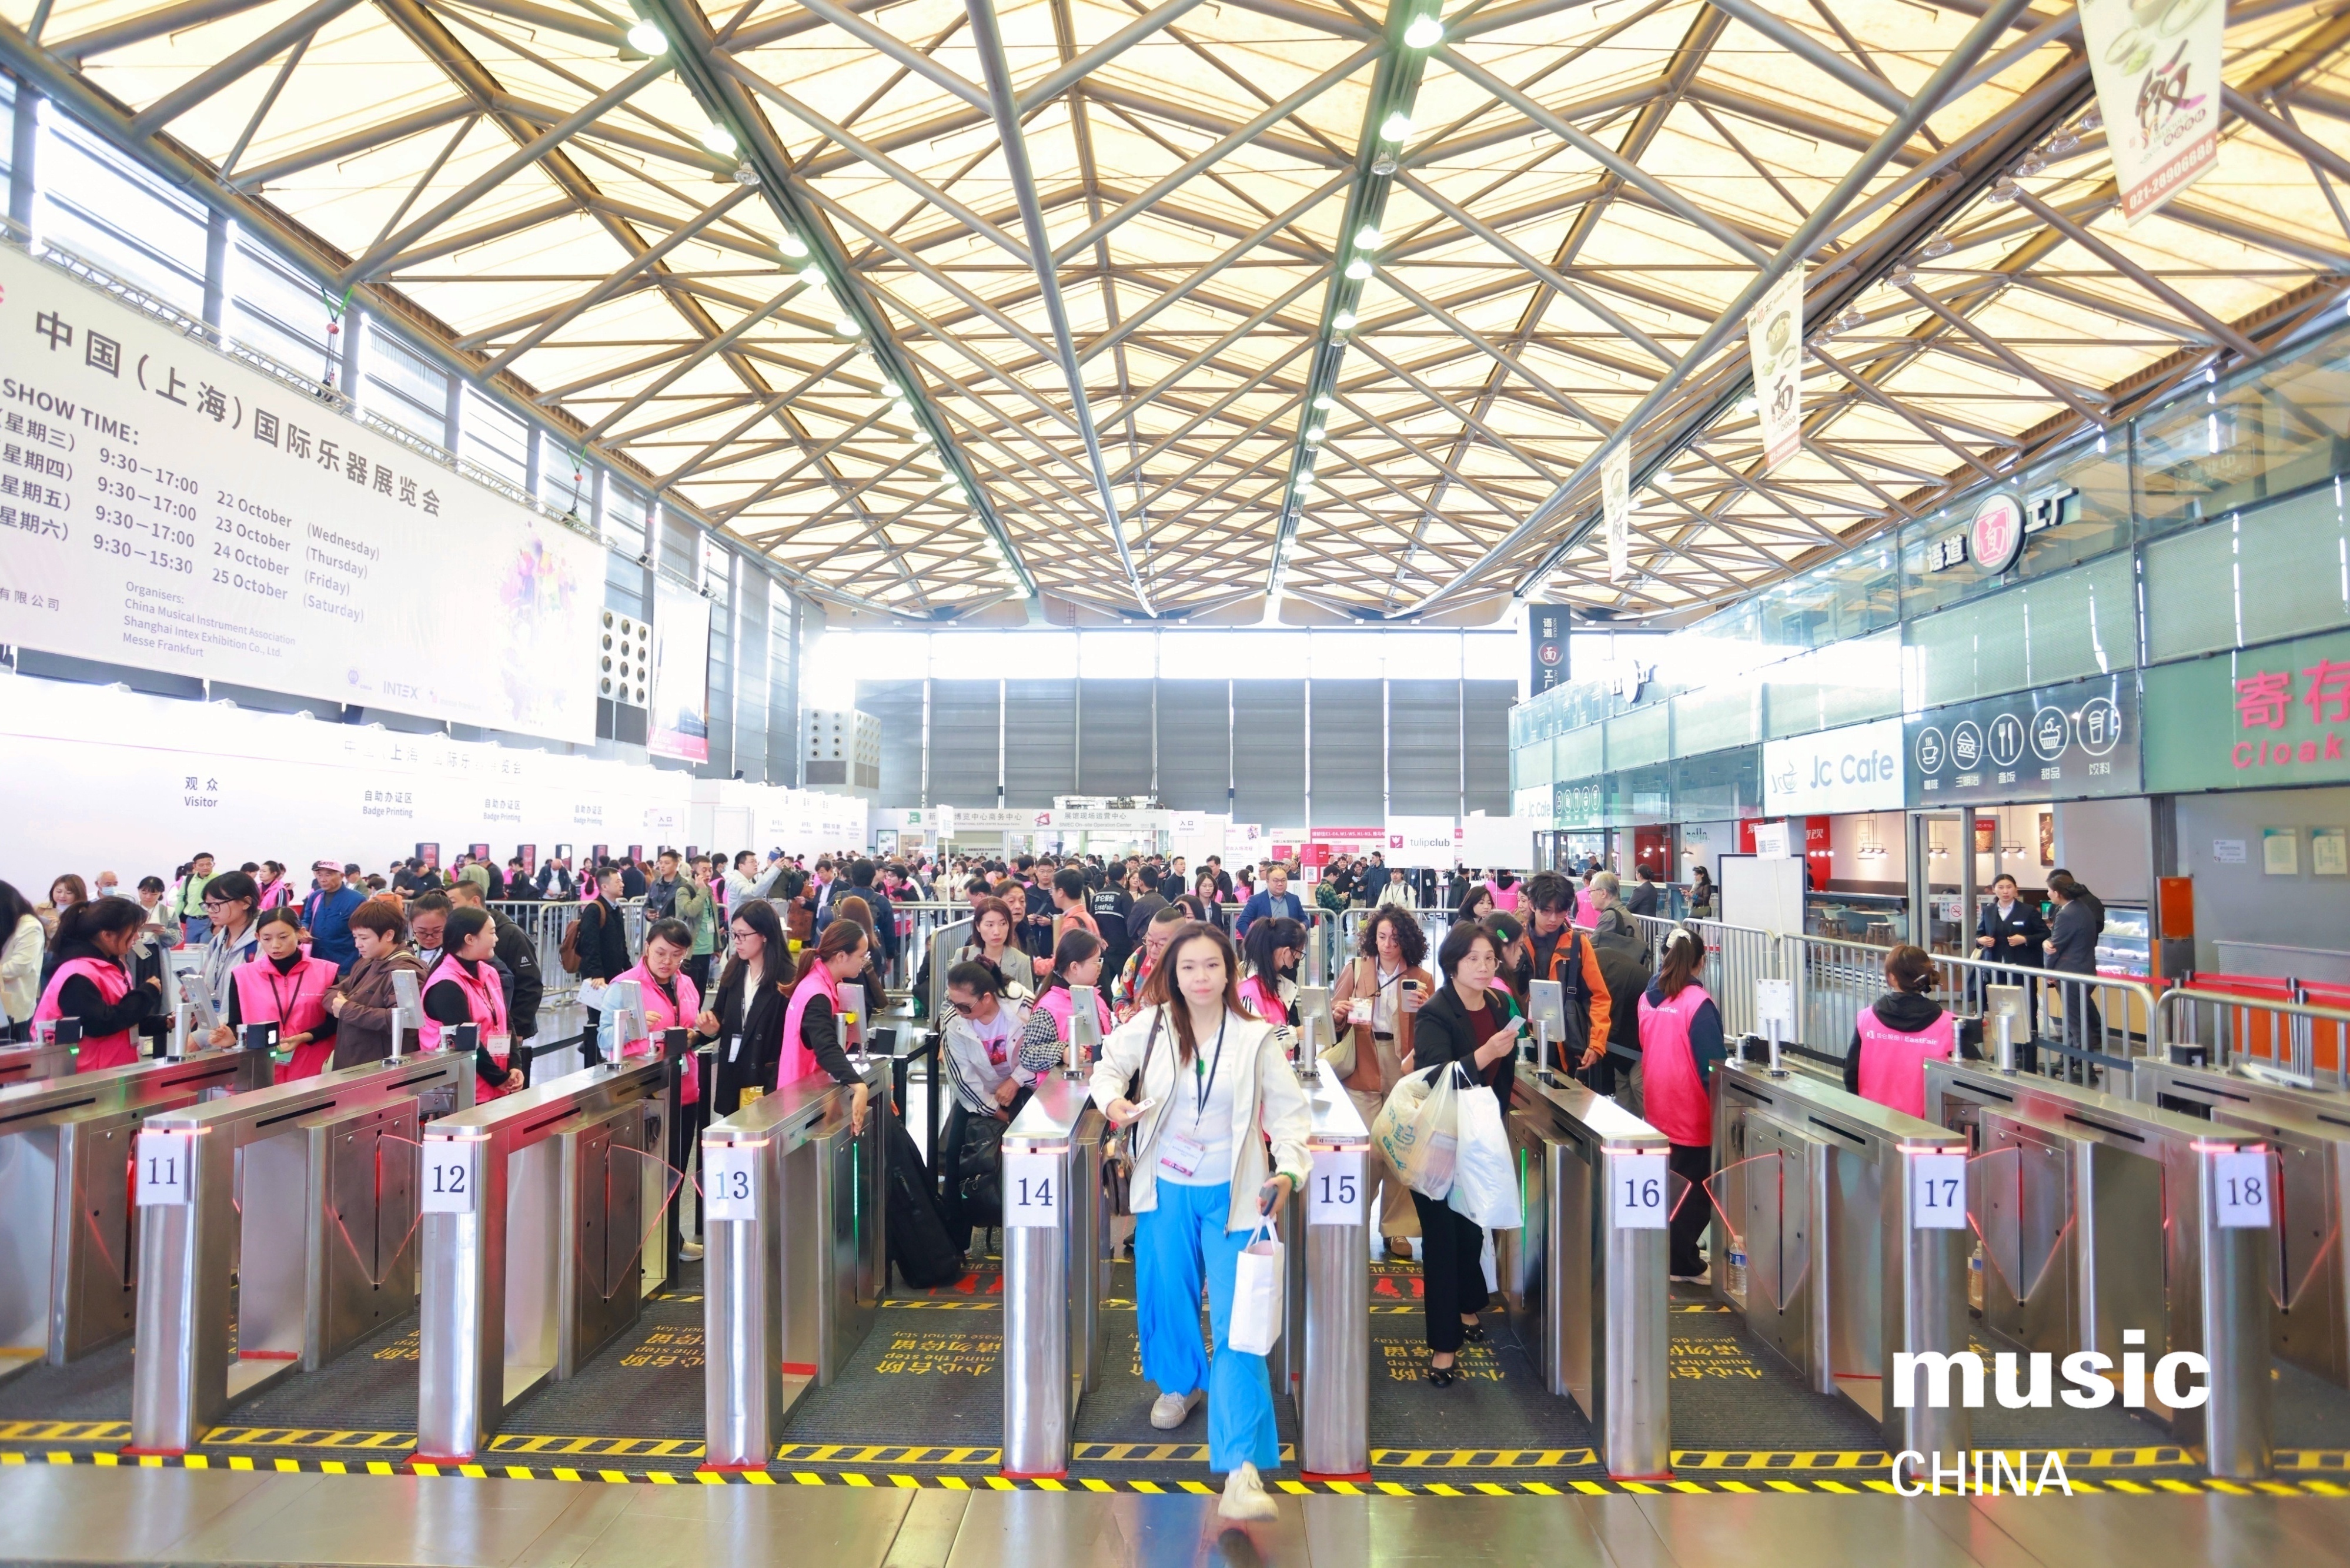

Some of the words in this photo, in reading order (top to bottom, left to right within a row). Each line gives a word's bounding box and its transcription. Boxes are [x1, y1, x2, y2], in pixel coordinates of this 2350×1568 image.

[2129, 138, 2214, 210] 021-28906688
[2, 378, 75, 420] SHOW
[81, 407, 139, 446] TIME:
[216, 490, 233, 508] 22
[238, 499, 292, 528] October
[307, 522, 380, 561] (Wednesday)
[1927, 534, 1964, 573] 语道
[2024, 486, 2077, 533] 工厂
[215, 516, 232, 533] 23
[236, 523, 291, 551] October
[306, 546, 368, 580] (Thursday)
[213, 541, 231, 559] 24
[235, 549, 289, 576] October
[304, 569, 350, 597] (Friday)
[0, 589, 60, 611] 有限公司
[126, 581, 185, 604] Organisers:
[212, 567, 229, 584] 25
[233, 574, 288, 600] October
[303, 593, 365, 623] (Saturday)
[123, 615, 173, 634] Shanghai
[175, 626, 199, 640] Intex
[201, 630, 247, 651] Exhibition
[125, 598, 155, 614] China
[158, 606, 195, 623] Musical
[196, 614, 248, 636] Instrument
[249, 627, 295, 646] Association
[123, 632, 155, 648] Messe
[157, 639, 204, 658] Frankfurt
[383, 681, 418, 700] INTEX
[2235, 659, 2350, 730] 寄存
[2231, 731, 2344, 768] Cloak
[1810, 755, 1833, 789] Jc
[1840, 750, 1894, 784] Cafe
[1955, 774, 1979, 787] 三明治
[1997, 771, 2015, 784] 盒饭
[2040, 767, 2060, 780] 甜品
[2088, 762, 2110, 775] 饮料
[185, 777, 218, 792] 观众
[364, 790, 413, 804] 自助办证区
[184, 796, 218, 808] Visitor
[363, 806, 385, 817] Badge
[386, 807, 413, 818] Printing
[484, 798, 521, 810] 自助办证区
[1536, 800, 1551, 817] Cafe
[483, 811, 499, 822] Badge
[500, 813, 521, 823] Printing
[573, 816, 586, 825] Badge
[587, 817, 603, 827] Printing
[928, 813, 1022, 821] 新博览中心商务中心
[1410, 838, 1450, 848] tulipclub
[1904, 1036, 1937, 1045] EastFair
[148, 1157, 178, 1185] 11
[433, 1165, 466, 1193] 12
[716, 1171, 750, 1199] 13
[1017, 1177, 1053, 1206] 14
[1319, 1175, 1356, 1204] 15
[1624, 1179, 1660, 1208] 16
[1924, 1179, 1958, 1208] 17
[2227, 1177, 2262, 1206] 18
[635, 1346, 670, 1354] step
[890, 1339, 1002, 1353] 请勿停留
[874, 1360, 992, 1376] 小心台阶
[1670, 1366, 1763, 1379] 小心台
